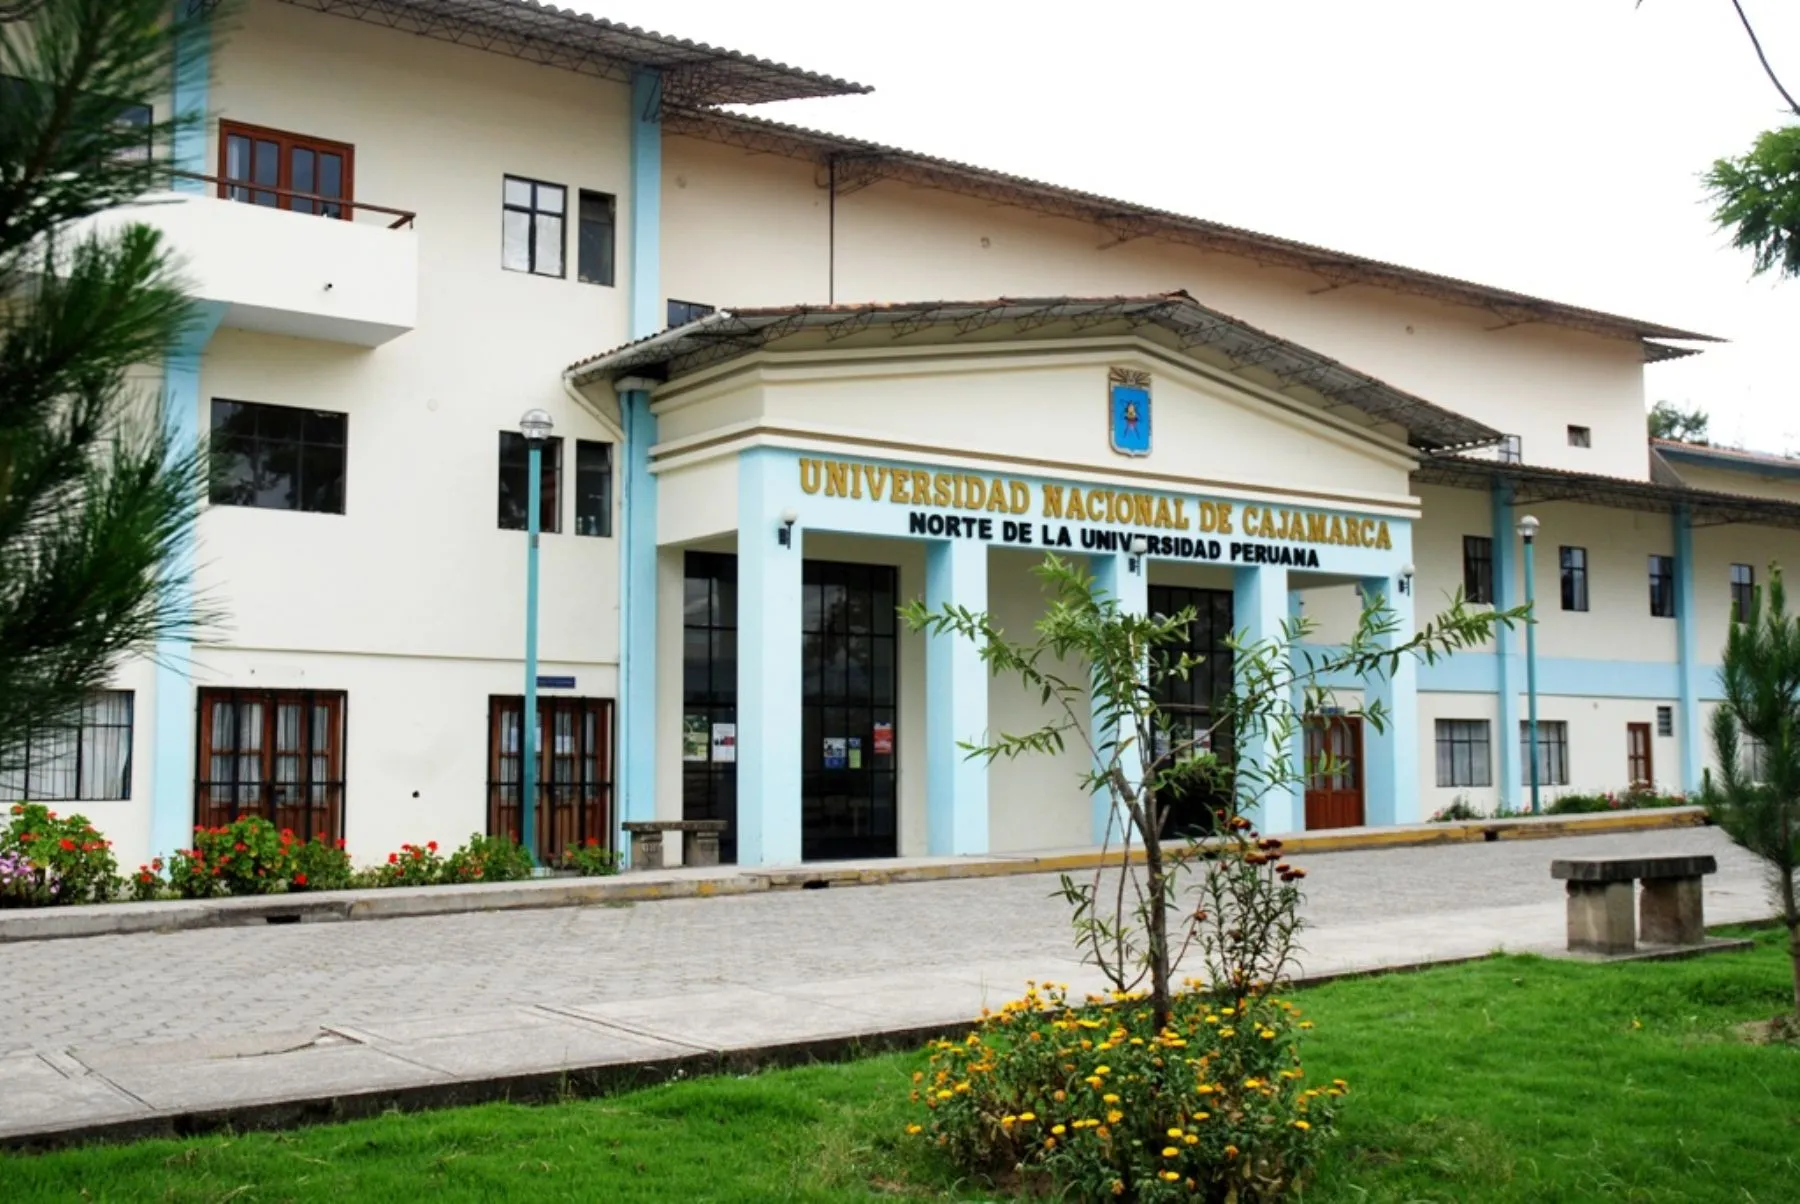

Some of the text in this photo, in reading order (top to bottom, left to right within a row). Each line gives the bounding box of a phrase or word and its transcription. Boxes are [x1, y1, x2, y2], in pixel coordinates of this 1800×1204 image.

[799, 458, 1392, 549] UNIVERSIDAD NACIONAL DE CAJAMARCA
[909, 512, 993, 540] NORTE
[1003, 520, 1032, 543] DE
[1042, 524, 1072, 547] LA
[1230, 541, 1319, 567] PERUANA
